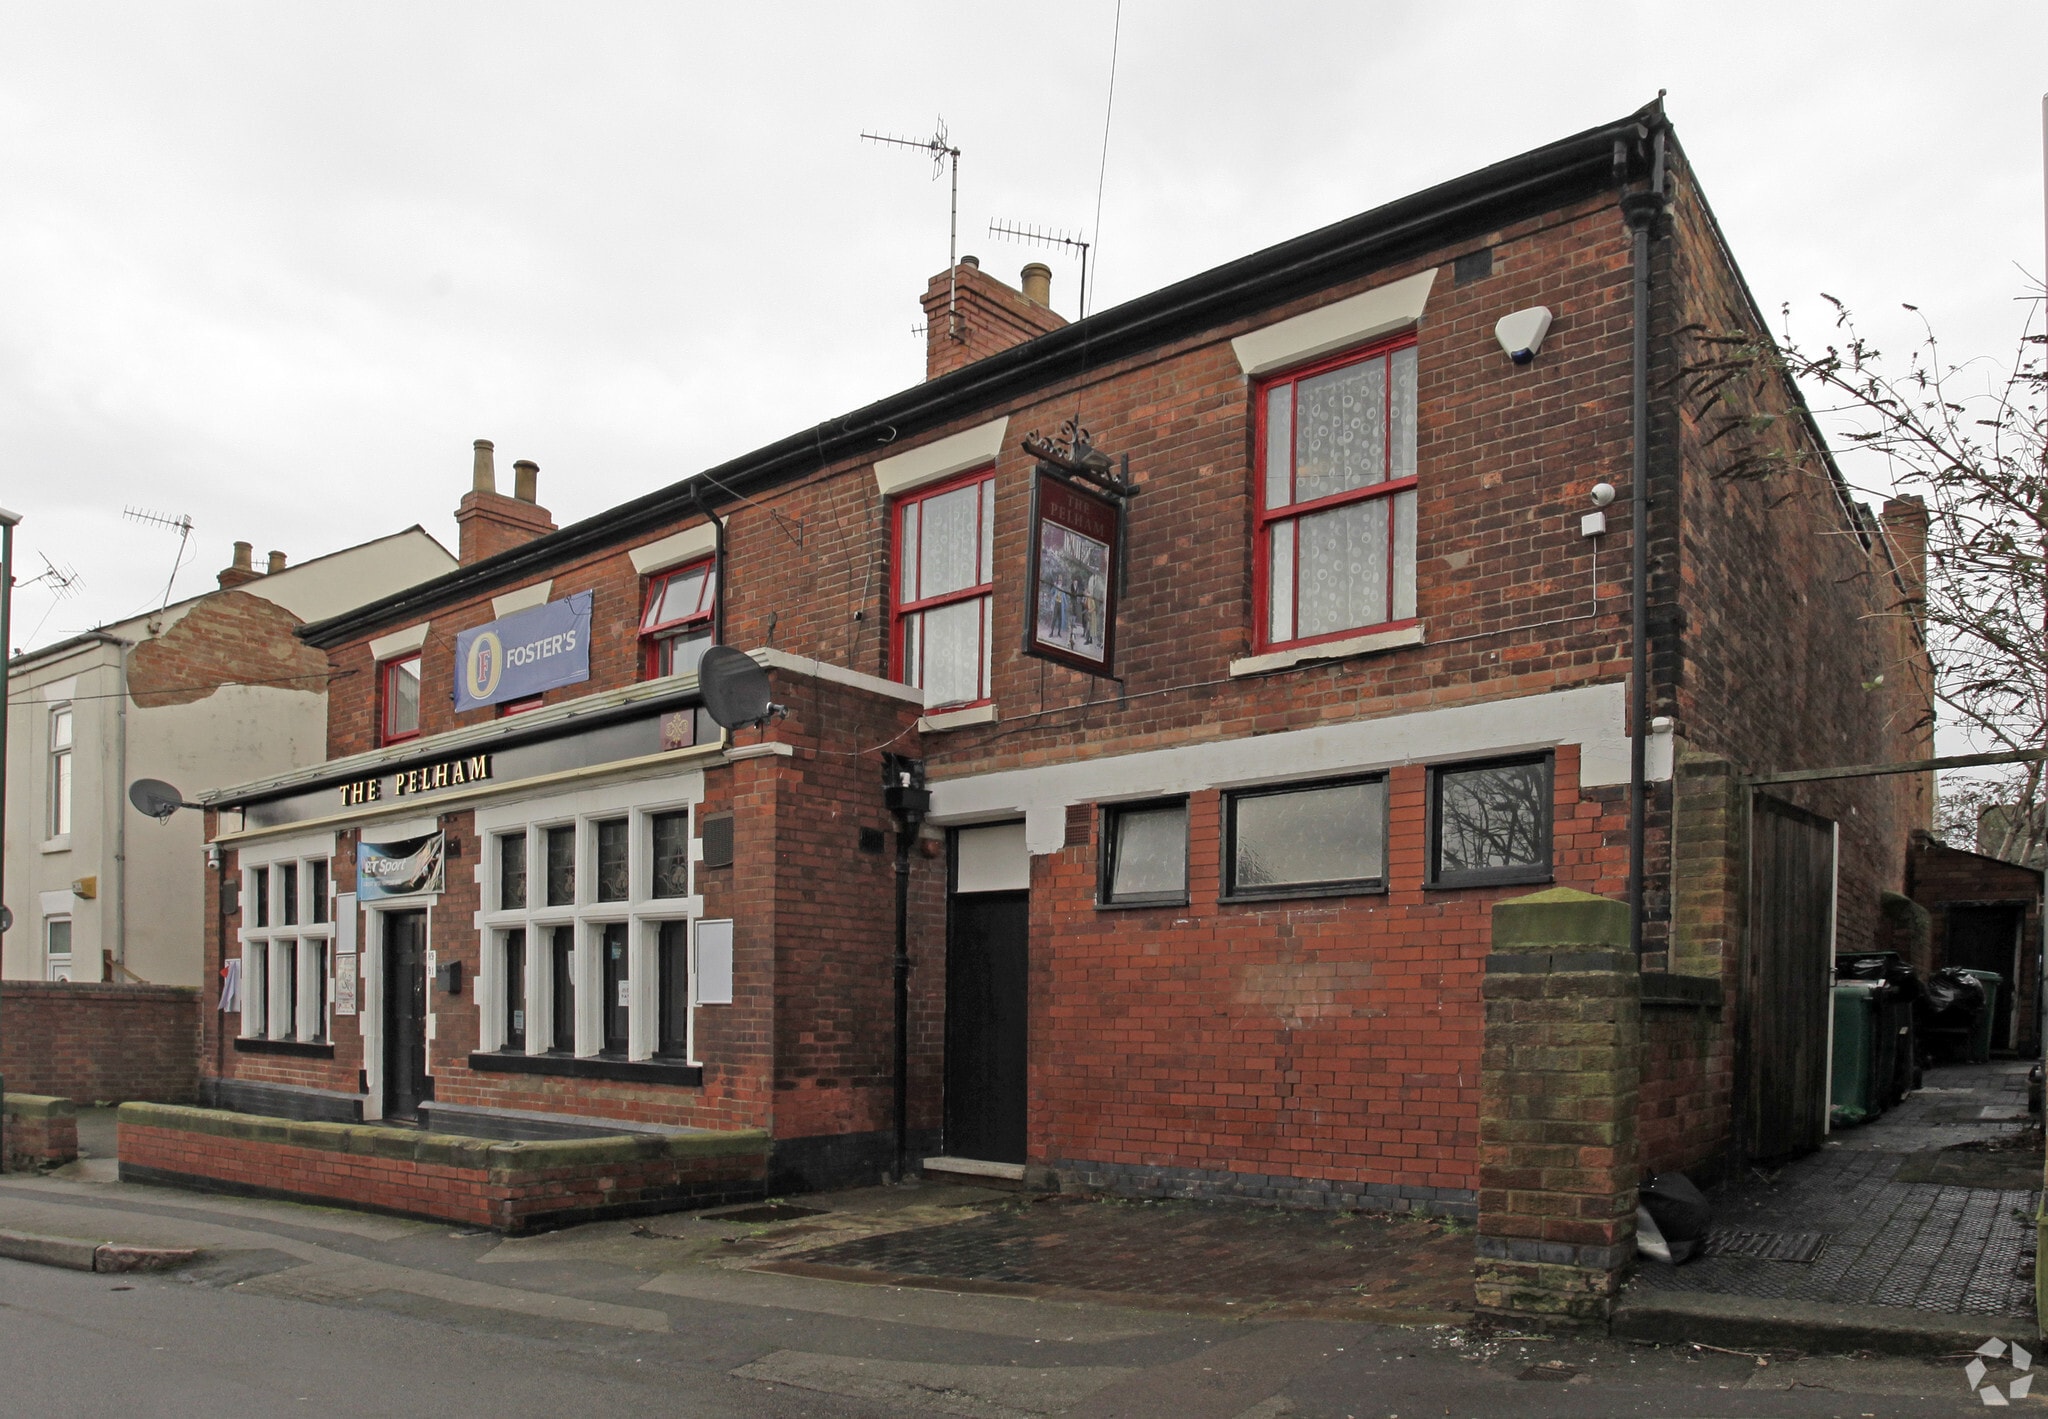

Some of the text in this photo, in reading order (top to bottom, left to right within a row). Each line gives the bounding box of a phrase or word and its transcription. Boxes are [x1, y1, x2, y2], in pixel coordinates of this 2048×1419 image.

[1050, 502, 1104, 538] PELHAM
[1067, 494, 1090, 514] THE
[507, 630, 576, 669] FOSTER'S
[340, 754, 491, 806] THE PELHAM
[379, 857, 407, 876] Sport
